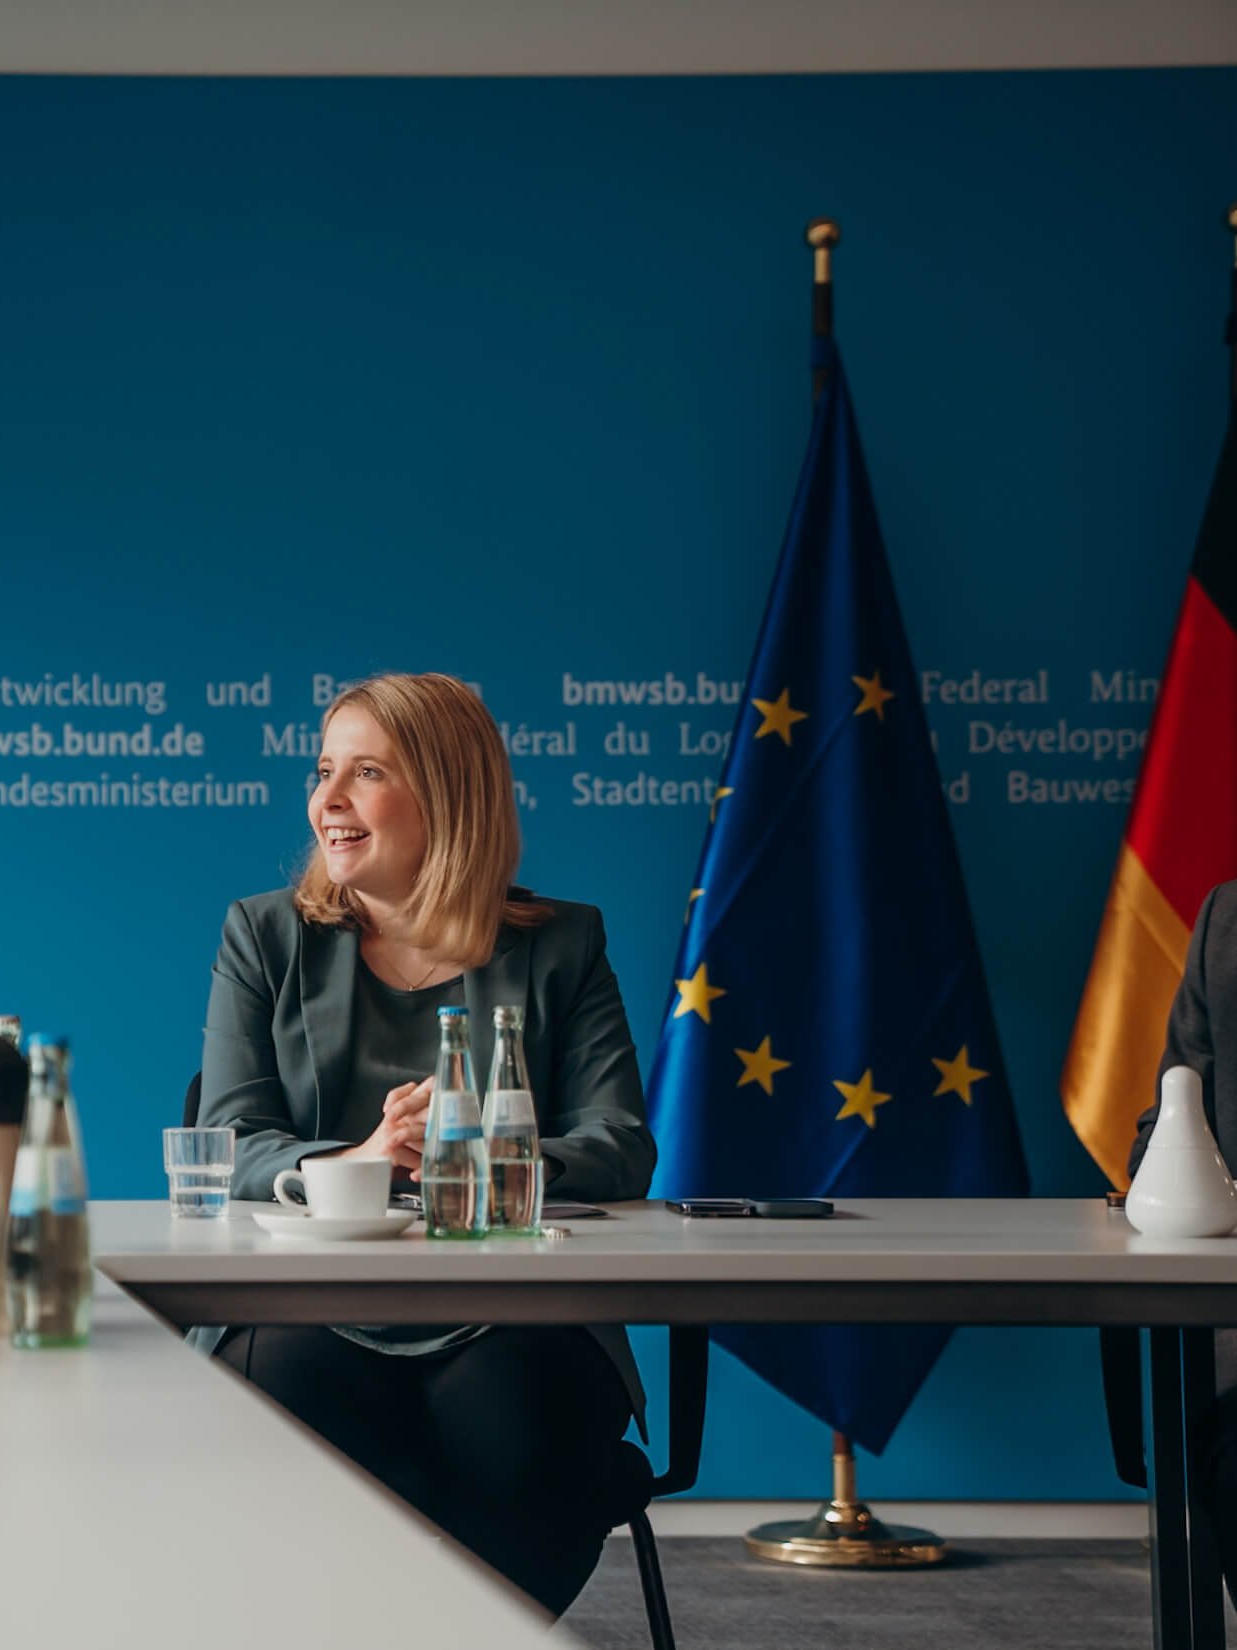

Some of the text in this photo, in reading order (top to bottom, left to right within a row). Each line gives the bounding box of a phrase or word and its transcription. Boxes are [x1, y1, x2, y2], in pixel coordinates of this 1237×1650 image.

[207, 672, 271, 706] und
[562, 671, 746, 706] bmwsb.bu
[920, 668, 1050, 705] Federal
[604, 721, 650, 756] du
[571, 770, 719, 807] Stadtent
